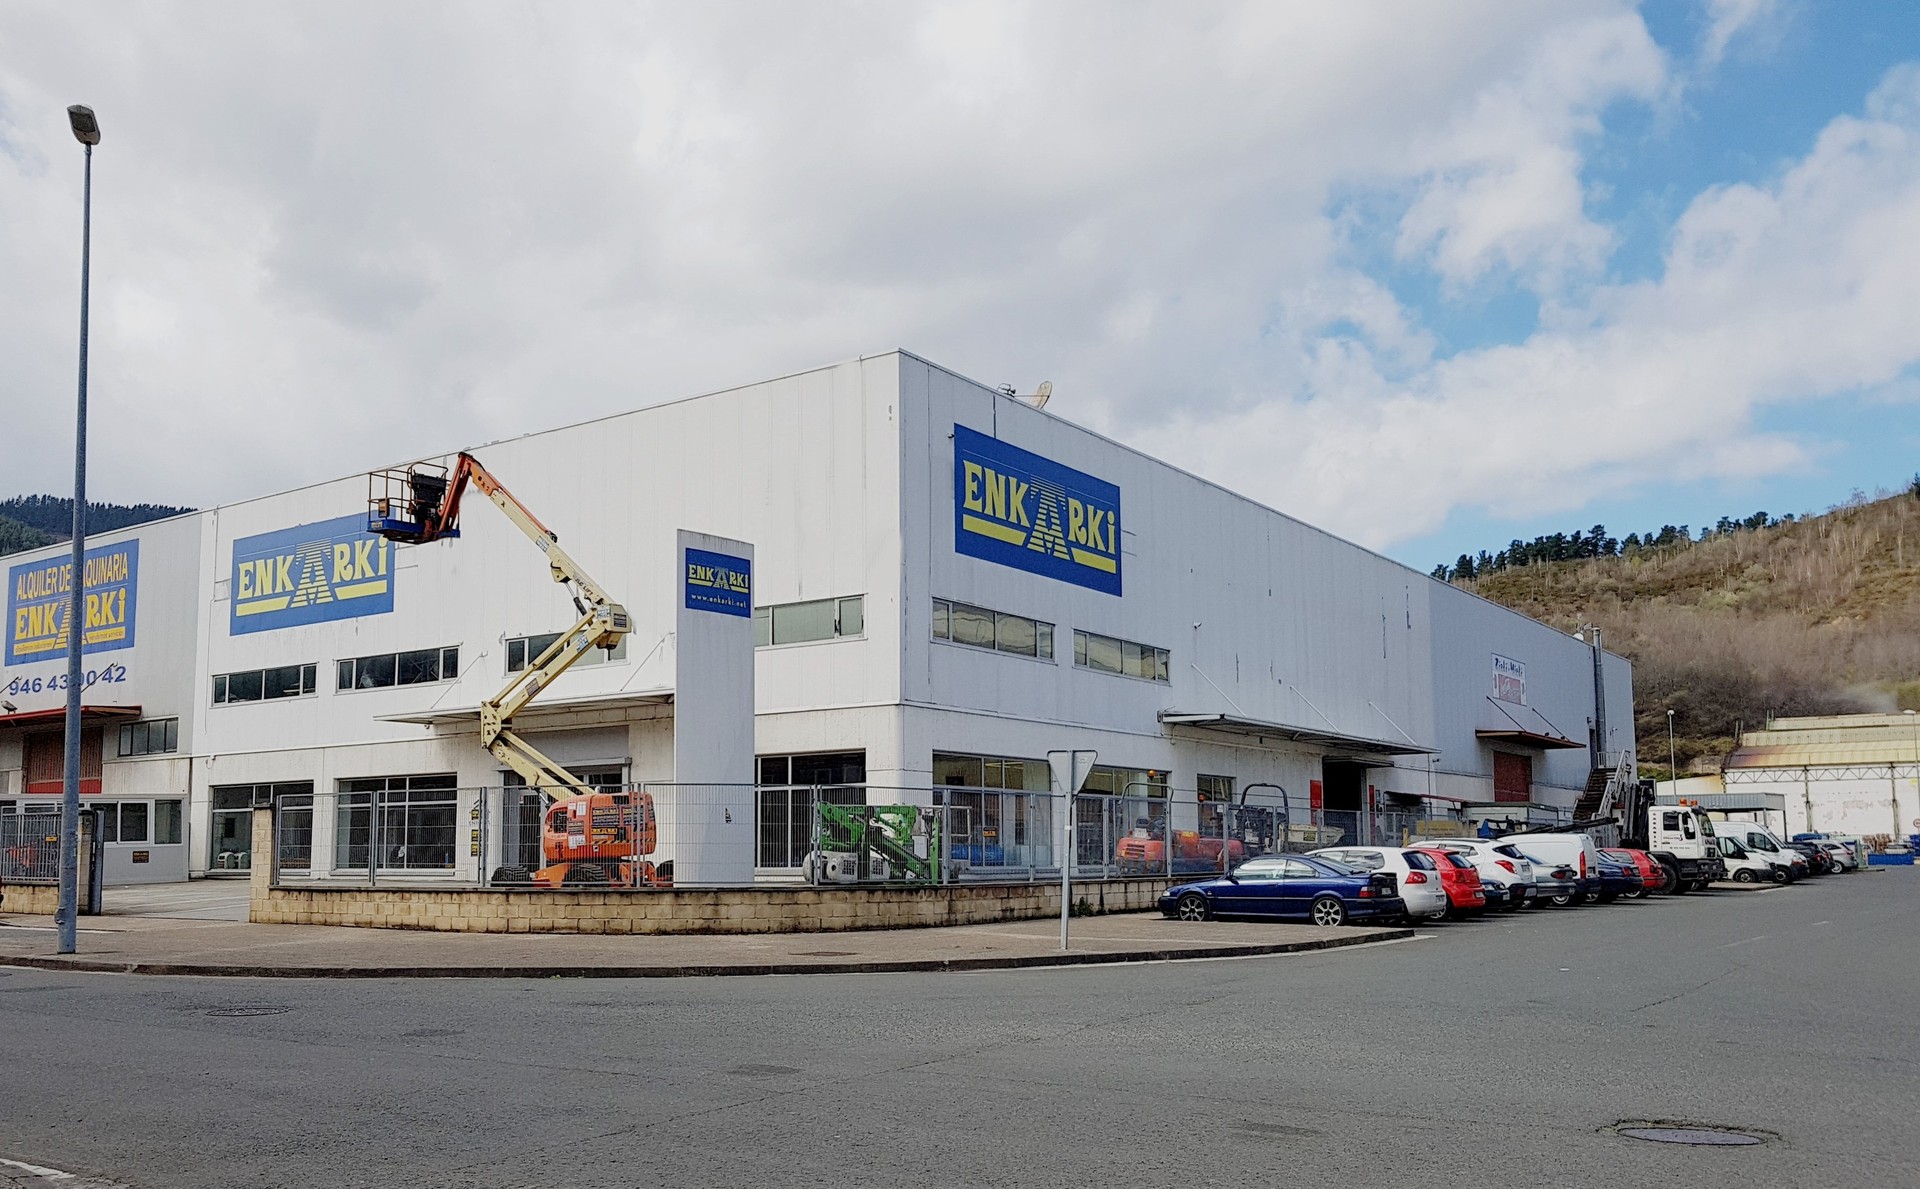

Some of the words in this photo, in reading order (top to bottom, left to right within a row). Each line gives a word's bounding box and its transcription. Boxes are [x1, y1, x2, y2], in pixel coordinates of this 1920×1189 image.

[16, 566, 58, 600] ALQUILER
[59, 563, 72, 593] DE
[83, 552, 129, 588] QUINARIA
[9, 677, 42, 696] 946
[47, 674, 69, 691] 43
[101, 666, 126, 683] 42
